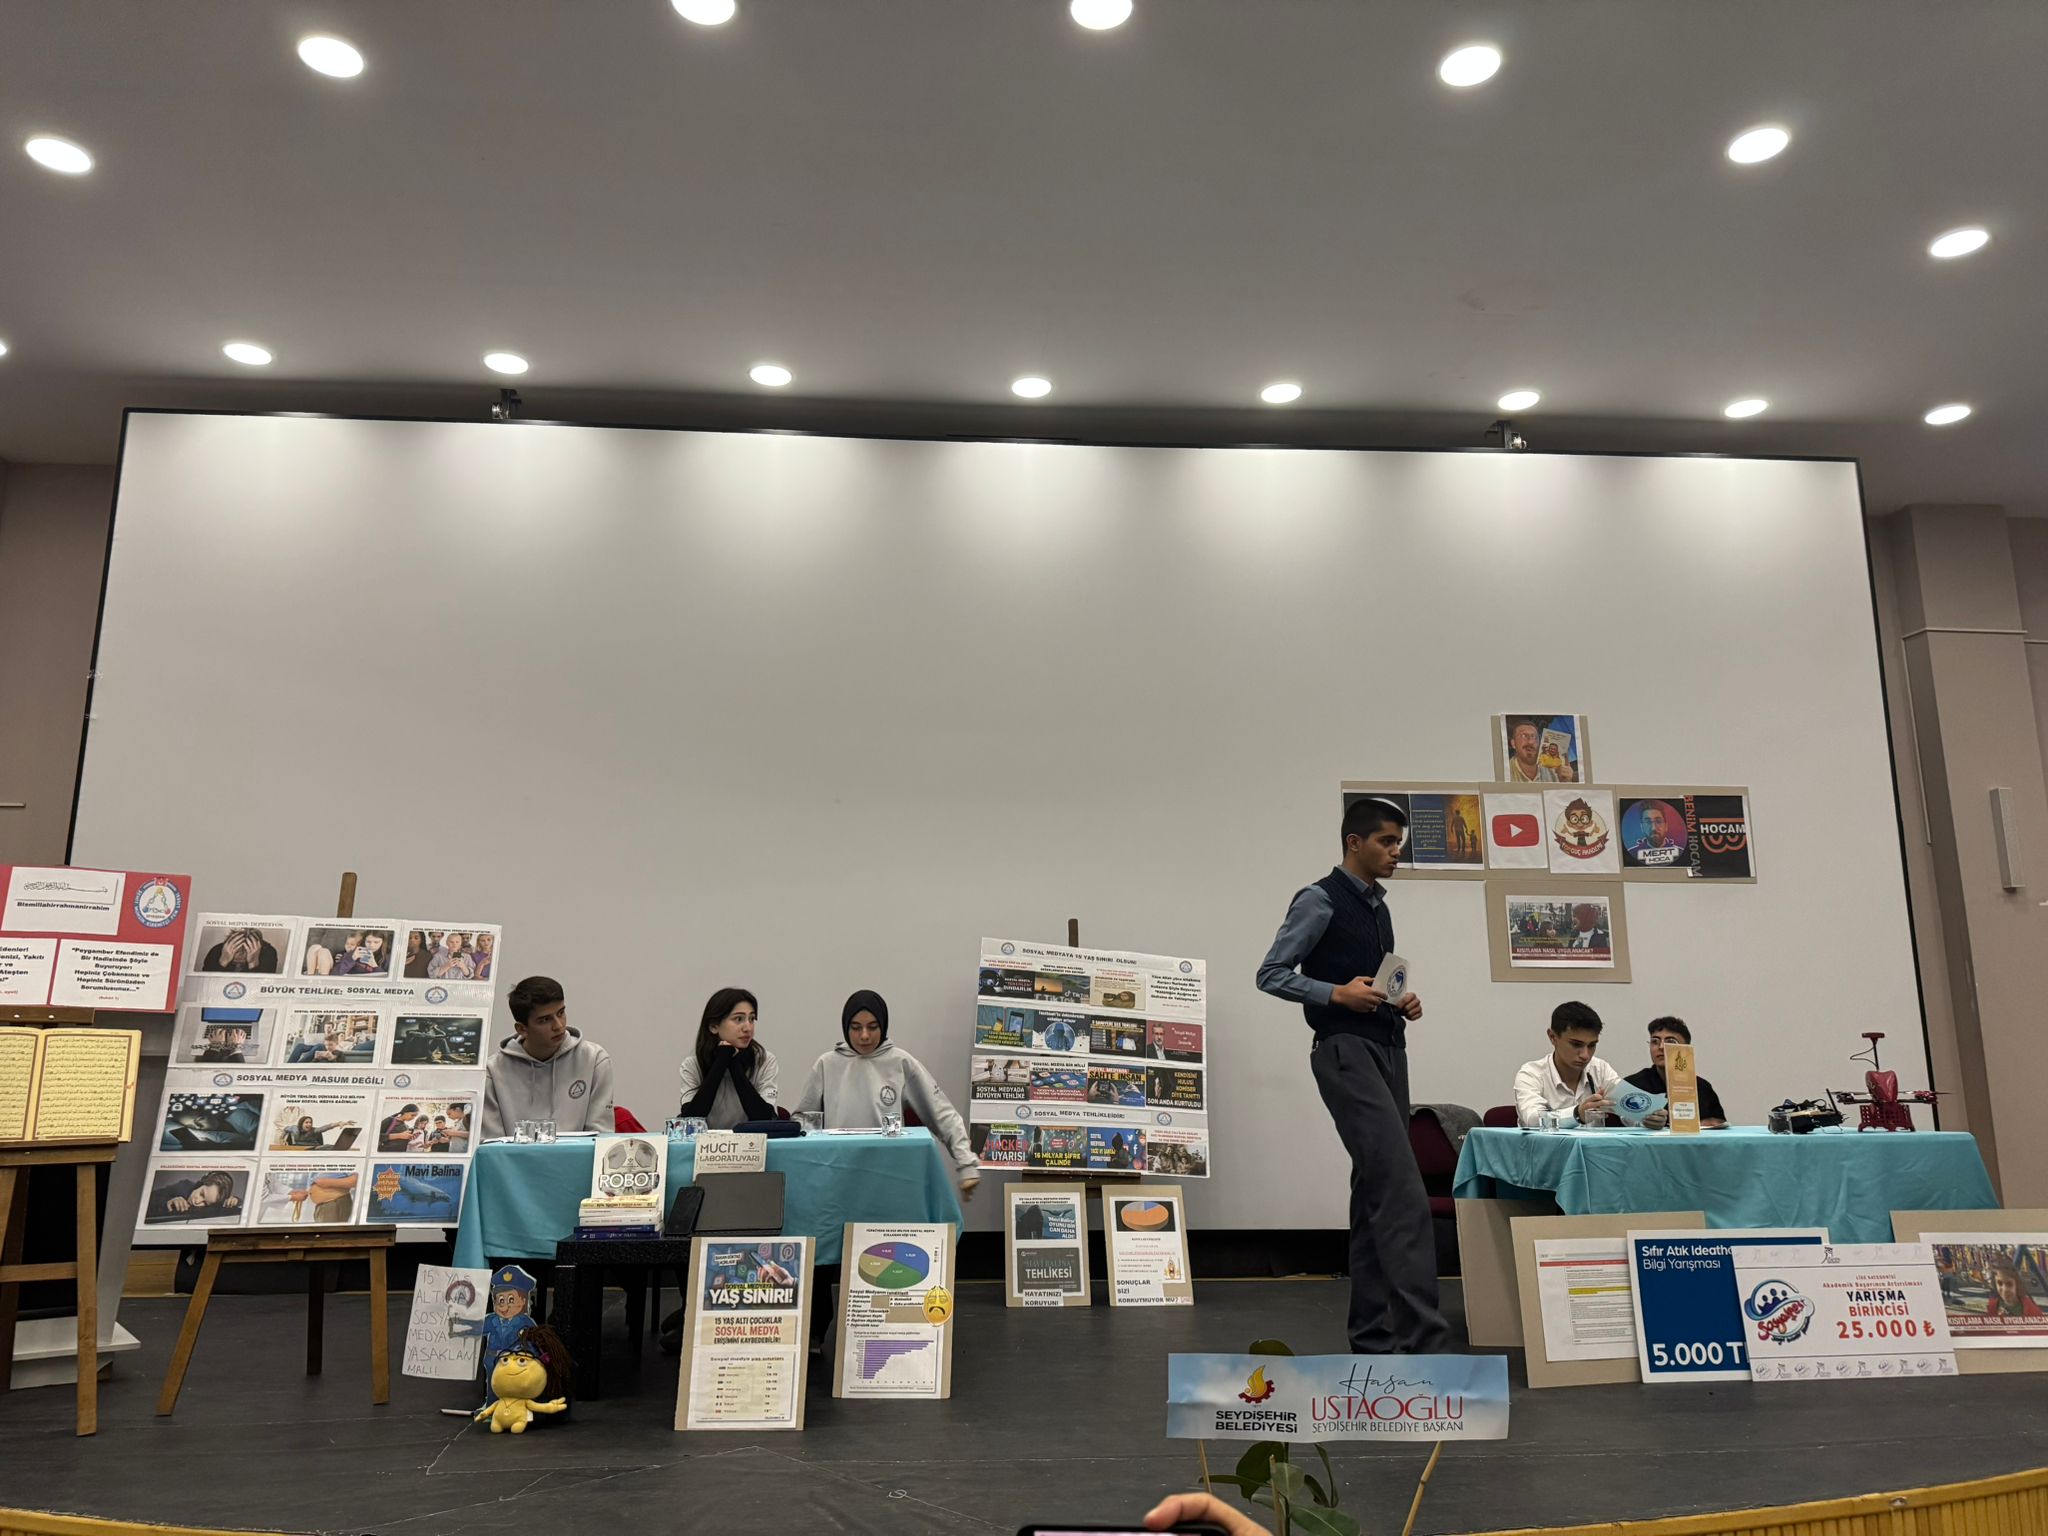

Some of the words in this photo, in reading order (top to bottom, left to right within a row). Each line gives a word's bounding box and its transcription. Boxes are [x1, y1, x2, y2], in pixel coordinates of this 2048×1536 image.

[1700, 824, 1746, 834] HOCAM
[1642, 849, 1675, 857] MERT
[1687, 835, 1703, 877] HOCAM
[17, 902, 110, 911] Bismillahirrahmanirrahim
[1046, 950, 1073, 958] MEDYAYA
[260, 986, 295, 994] BÜYÜK
[298, 987, 343, 995] TEHLİKE:
[236, 1074, 273, 1082] SOSYAL
[311, 1076, 349, 1084] MASUM
[352, 1076, 384, 1085] DEĞİL!
[1089, 1071, 1115, 1079] SAHTE
[1159, 1098, 1174, 1106] ANDA
[1174, 1100, 1201, 1108] KURTULDU
[700, 1142, 738, 1154] MUCİT
[986, 1139, 1029, 1152] HACKER
[992, 1151, 1026, 1161] UYARISI
[1042, 1151, 1063, 1159] MİLYAR
[1064, 1152, 1081, 1160] ŞİFRE
[405, 1166, 429, 1177] Mavi
[432, 1165, 460, 1177] Balina
[599, 1172, 659, 1188] ROBOT
[1642, 1245, 1664, 1257] Sıfır
[1666, 1245, 1689, 1256] Atık
[1643, 1258, 1667, 1272] Bilgi
[1668, 1259, 1721, 1272] Yarışması
[423, 1270, 434, 1285] 15
[1025, 1266, 1072, 1279] TEHLİKESİ
[709, 1288, 740, 1309] YAŞ
[742, 1288, 794, 1304] SINIRI!
[1846, 1290, 1906, 1305] YARIŞMA
[1849, 1302, 1909, 1317] BİRİNCİSİ
[714, 1317, 722, 1325] 15
[722, 1317, 735, 1326] YAŞ
[749, 1317, 783, 1326] ÇOCUKLAR
[1947, 1317, 1984, 1326] KISITLAMA
[1984, 1316, 2003, 1325] NASIL
[2003, 1316, 2048, 1325] UYGULANACA
[715, 1326, 747, 1336] SOSYAL
[750, 1326, 780, 1336] MEDYA
[1836, 1319, 1917, 1339] 25.000
[409, 1328, 447, 1343] MEDYA
[1653, 1342, 1724, 1366] 5.000
[1339, 1362, 1434, 1399] Hasan
[1311, 1394, 1463, 1421] USTAOĞLU
[1216, 1410, 1297, 1422] SEYDİŞEHİR
[1215, 1421, 1298, 1434] BELEDİYESİ
[1312, 1421, 1368, 1434] SEYDİŞEHİR
[1370, 1421, 1420, 1433] BELEDİYE
[1422, 1421, 1464, 1433] BAŞKANI
